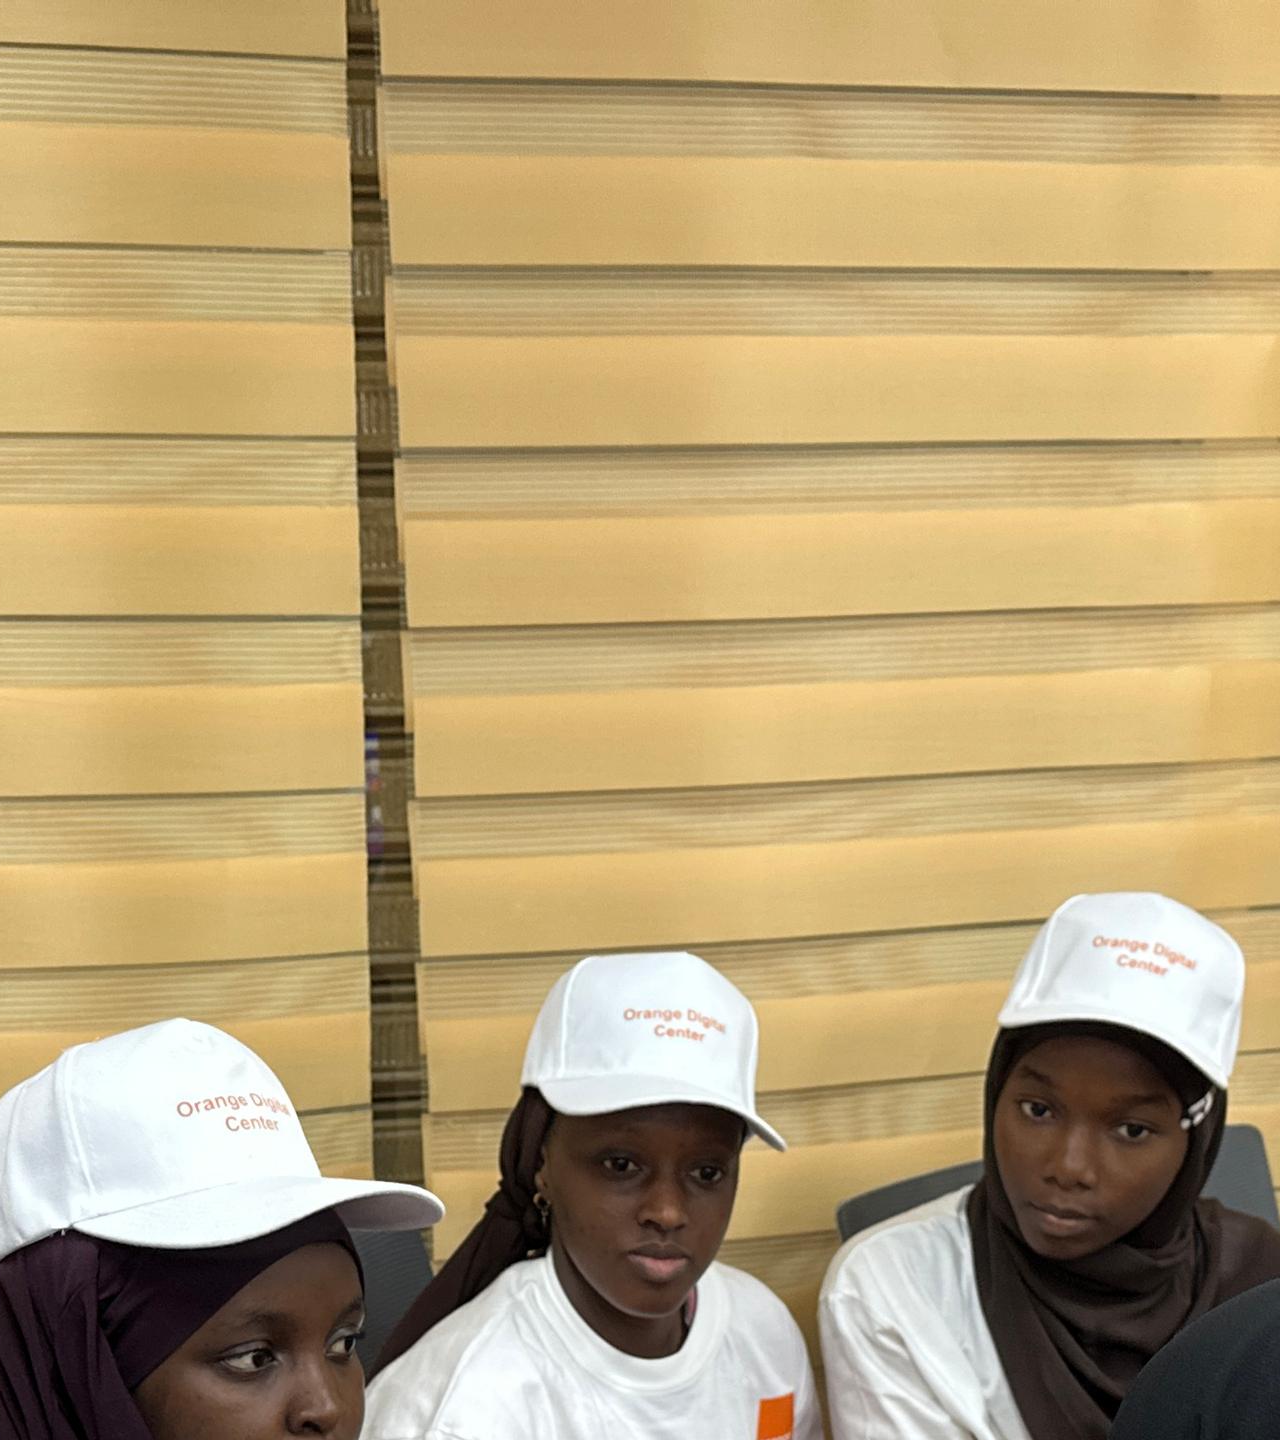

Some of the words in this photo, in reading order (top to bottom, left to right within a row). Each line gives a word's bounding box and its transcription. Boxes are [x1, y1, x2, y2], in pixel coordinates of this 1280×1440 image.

[1092, 935, 1149, 953] Orange
[1116, 953, 1168, 976] Center
[623, 1008, 683, 1022] Orange
[654, 1023, 706, 1043] Center
[176, 1095, 248, 1118] Orange
[225, 1116, 280, 1132] Center
